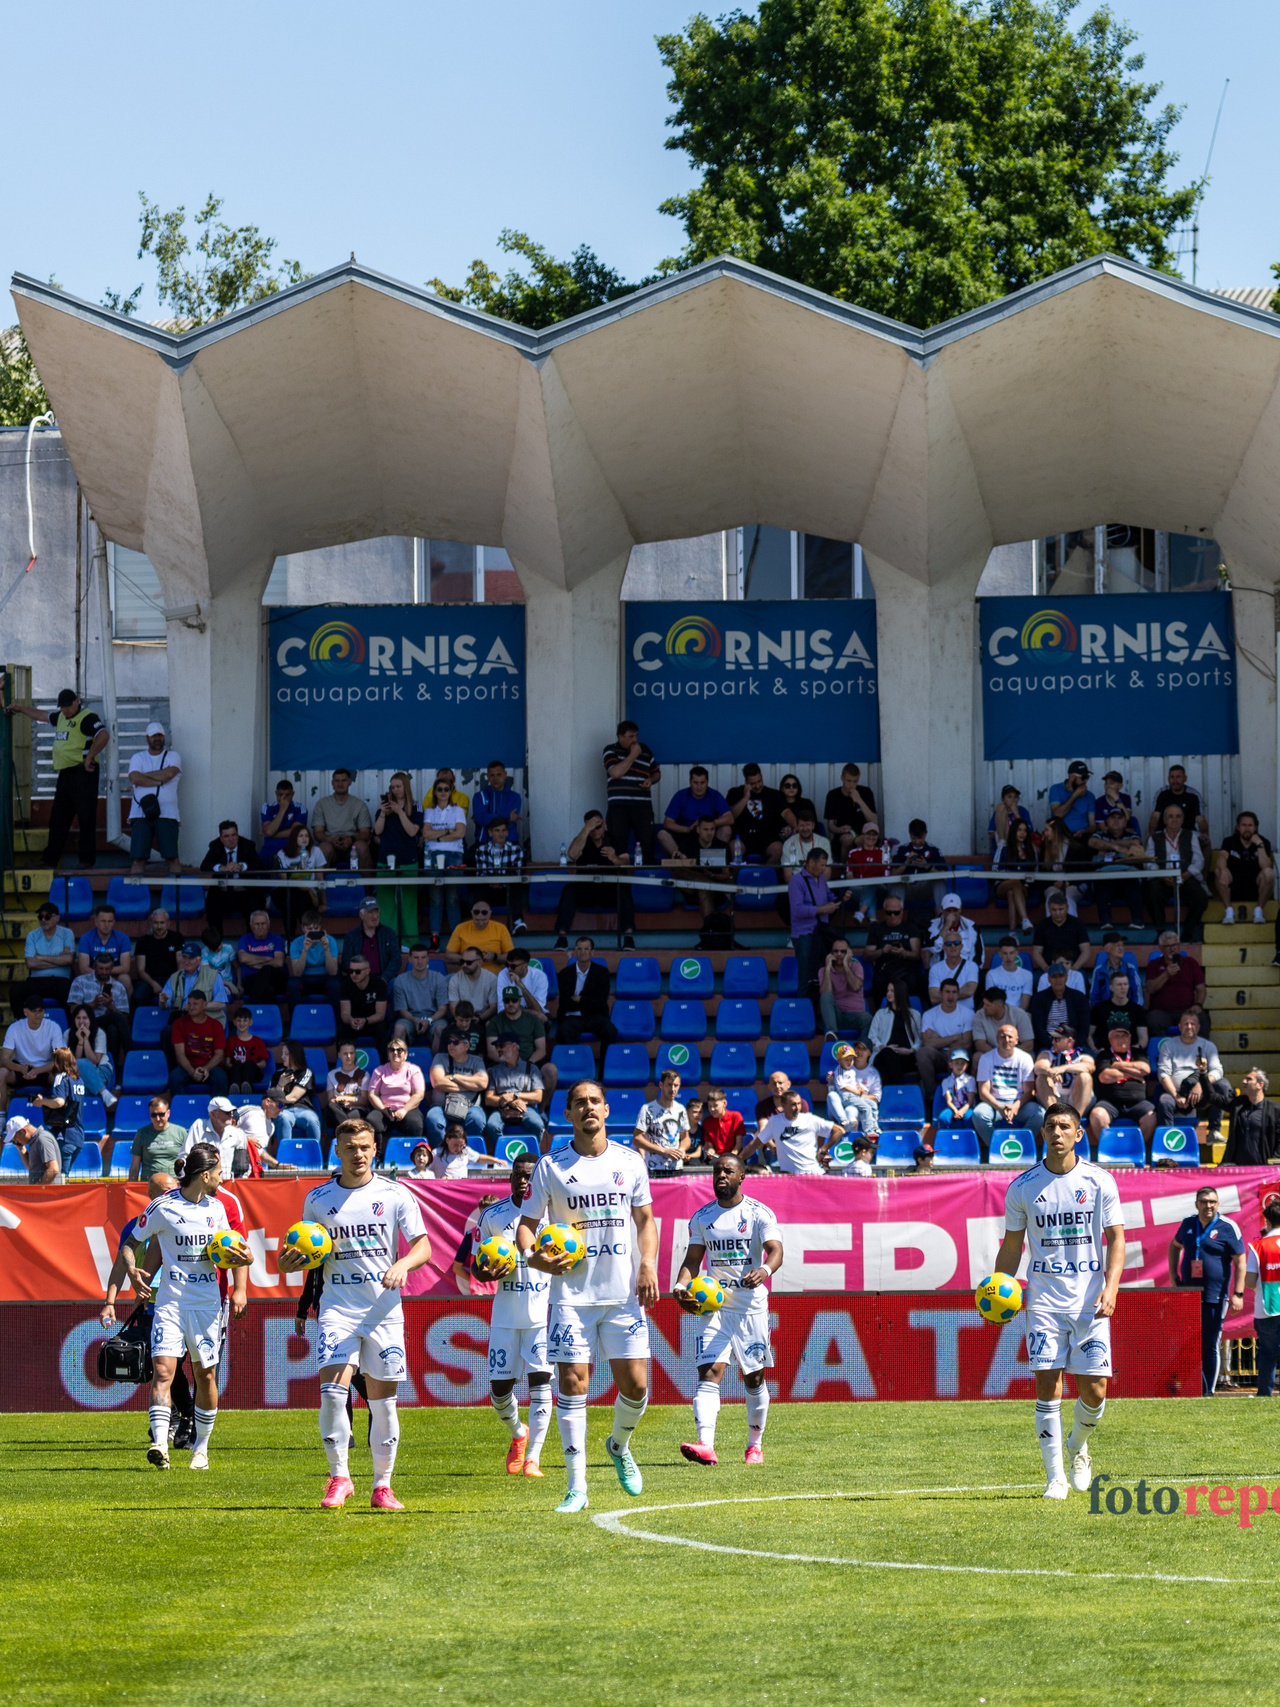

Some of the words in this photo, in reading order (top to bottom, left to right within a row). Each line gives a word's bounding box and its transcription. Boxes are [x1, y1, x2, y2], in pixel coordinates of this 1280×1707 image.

[633, 675, 759, 700] aquapark
[773, 677, 788, 695] &
[800, 675, 876, 700] sports
[989, 669, 1117, 695] aquapark
[1129, 669, 1144, 688] &
[1157, 669, 1233, 694] sports
[277, 680, 405, 706] aquapark
[417, 683, 432, 701] &
[444, 680, 520, 706] sports
[22, 875, 31, 890] 9
[1239, 948, 1247, 963] 7
[1236, 990, 1246, 1005] 6
[1239, 1034, 1248, 1048] 5
[567, 1193, 626, 1210] UNIBET
[1035, 1211, 1093, 1228] UNIBET
[330, 1223, 387, 1240] UNIBET
[175, 1234, 213, 1246] UNIBE
[706, 1238, 752, 1251] UNIBET
[1032, 1260, 1100, 1273] ELSACO
[169, 1271, 217, 1283] ELSAC
[332, 1271, 386, 1285] ELSAC
[503, 1281, 548, 1292] ELSAC
[987, 1286, 996, 1295] 12
[155, 1327, 163, 1344] 8
[318, 1332, 339, 1353] 33
[550, 1323, 574, 1347] 44
[1029, 1332, 1047, 1355] 27
[489, 1348, 507, 1368] 83
